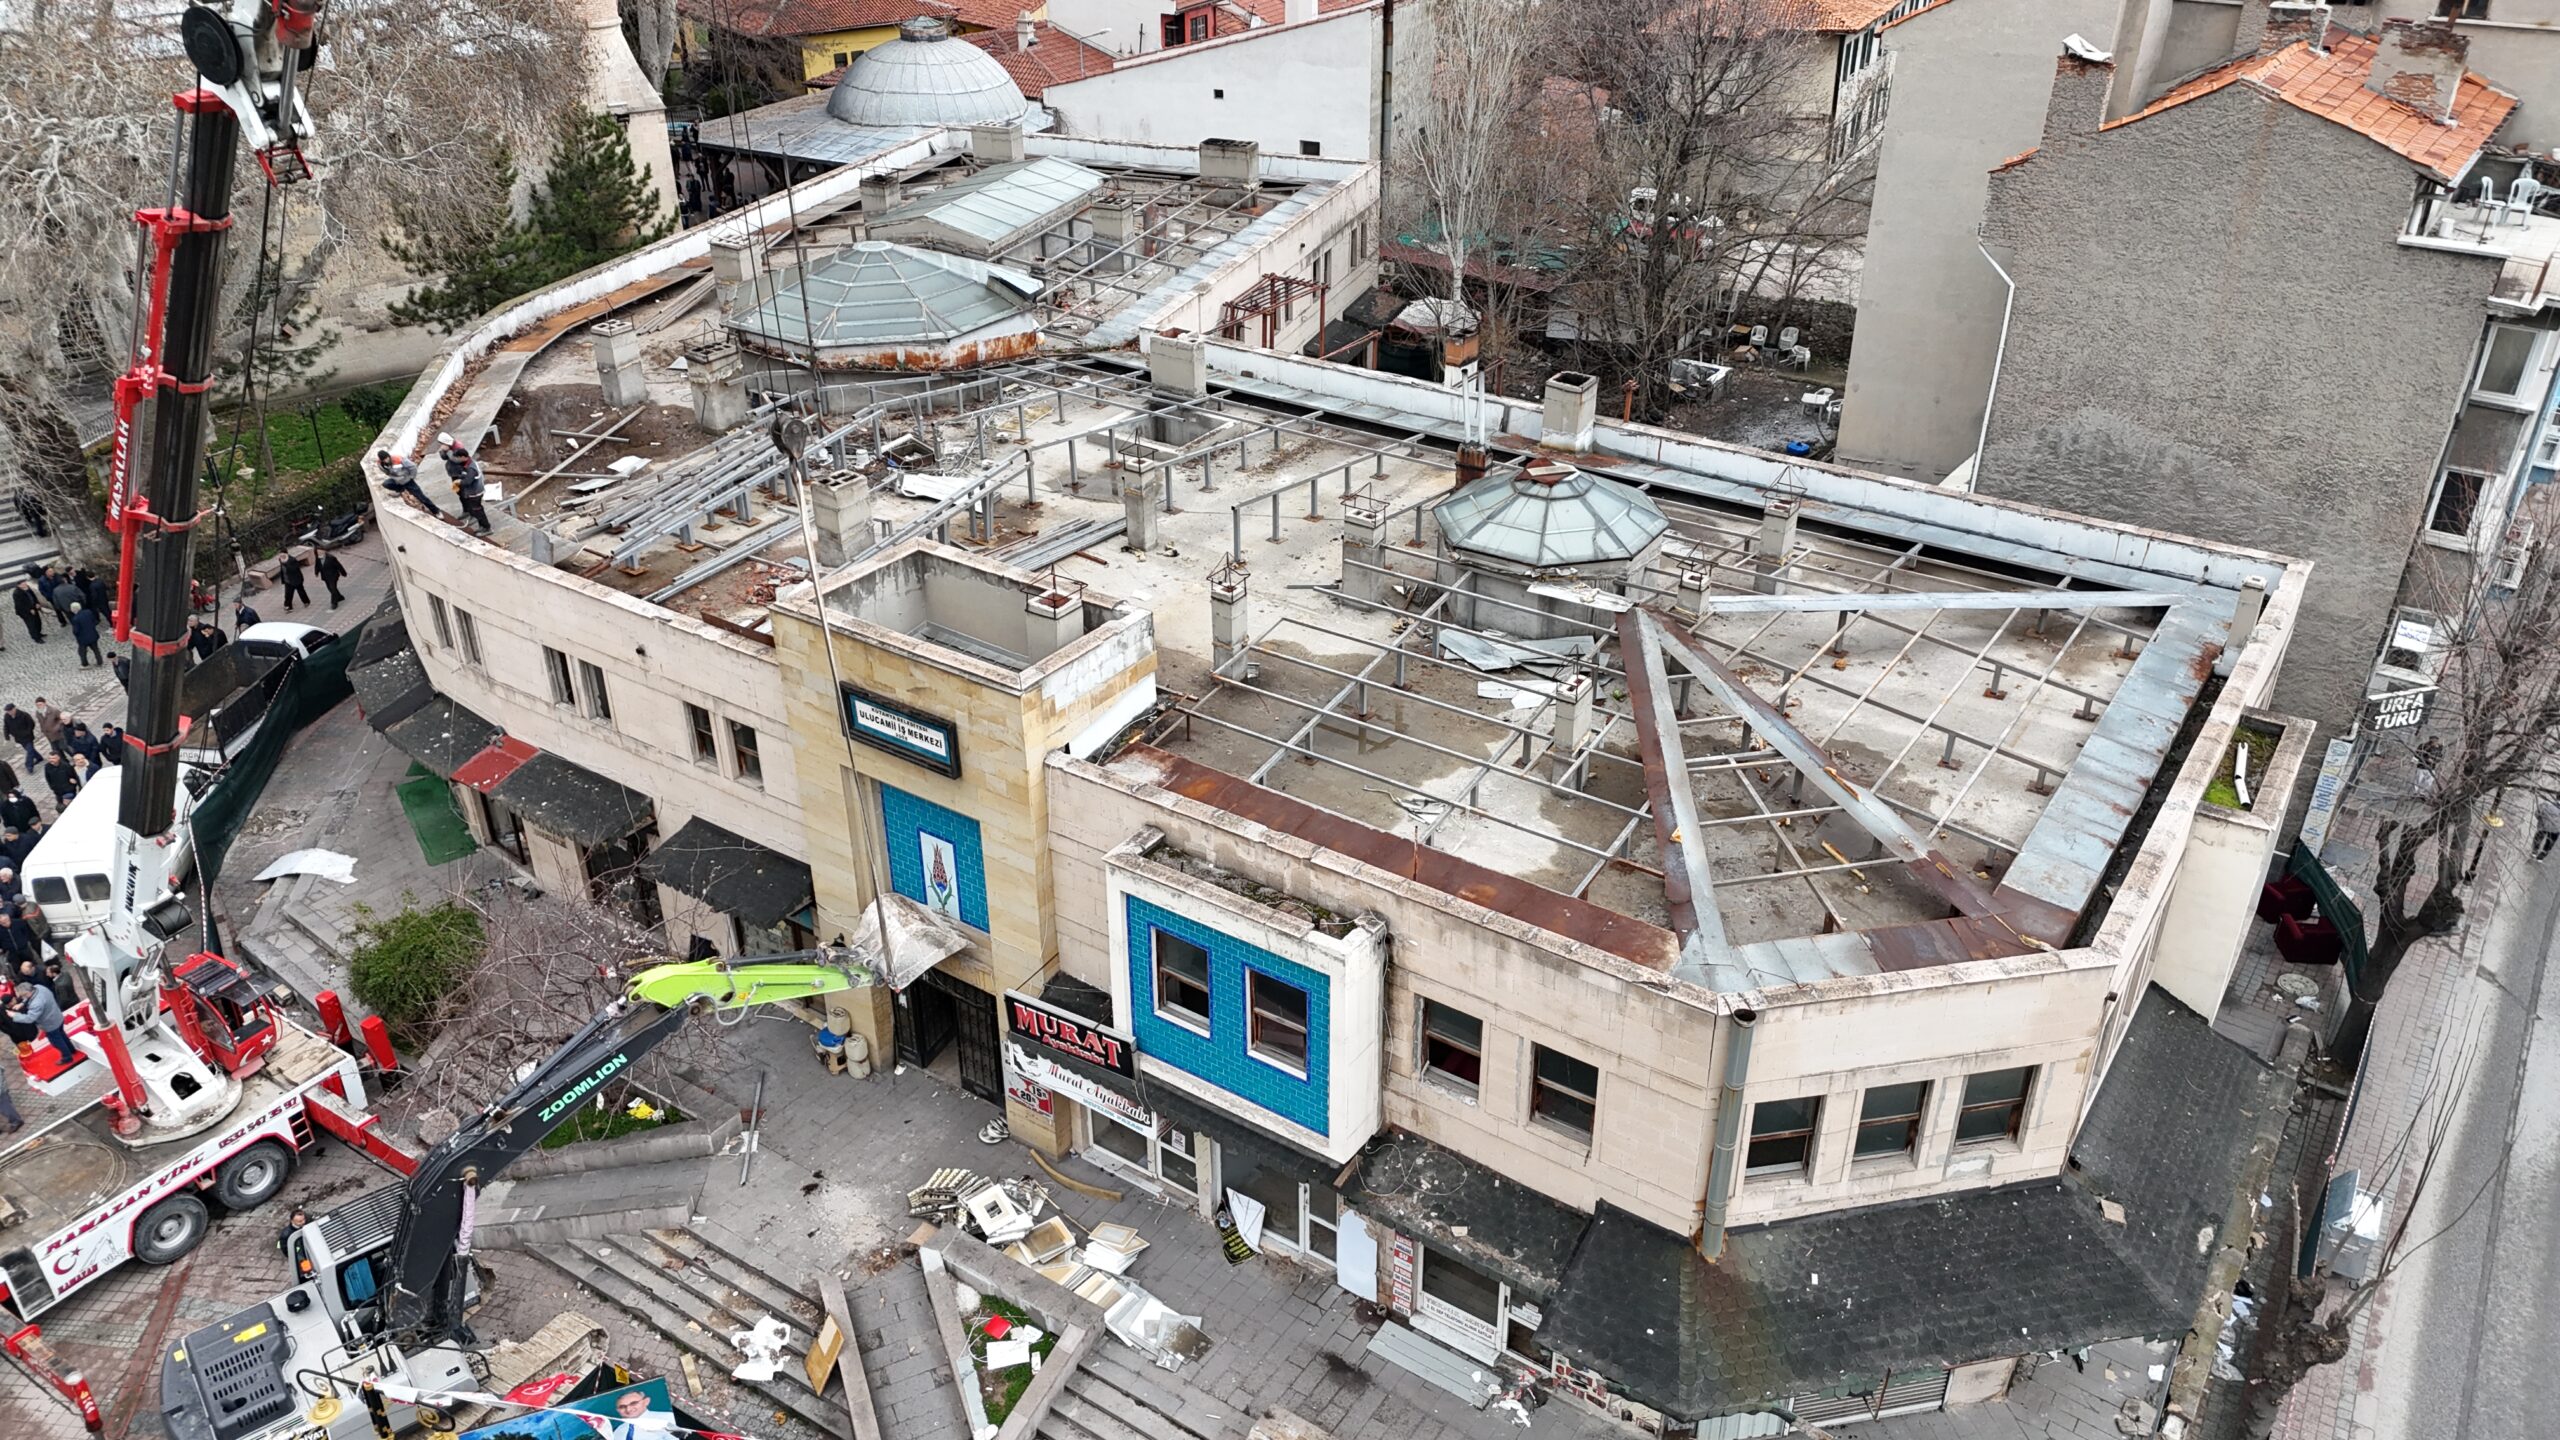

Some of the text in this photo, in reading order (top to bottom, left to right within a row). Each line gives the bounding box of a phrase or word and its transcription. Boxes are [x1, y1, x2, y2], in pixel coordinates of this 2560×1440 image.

[2374, 708, 2423, 730] TURU
[2380, 693, 2424, 714] URFA
[1014, 1002, 1122, 1069] MURAT
[538, 1053, 628, 1122] ZOOMLION
[46, 1184, 152, 1255] RAMAZAN
